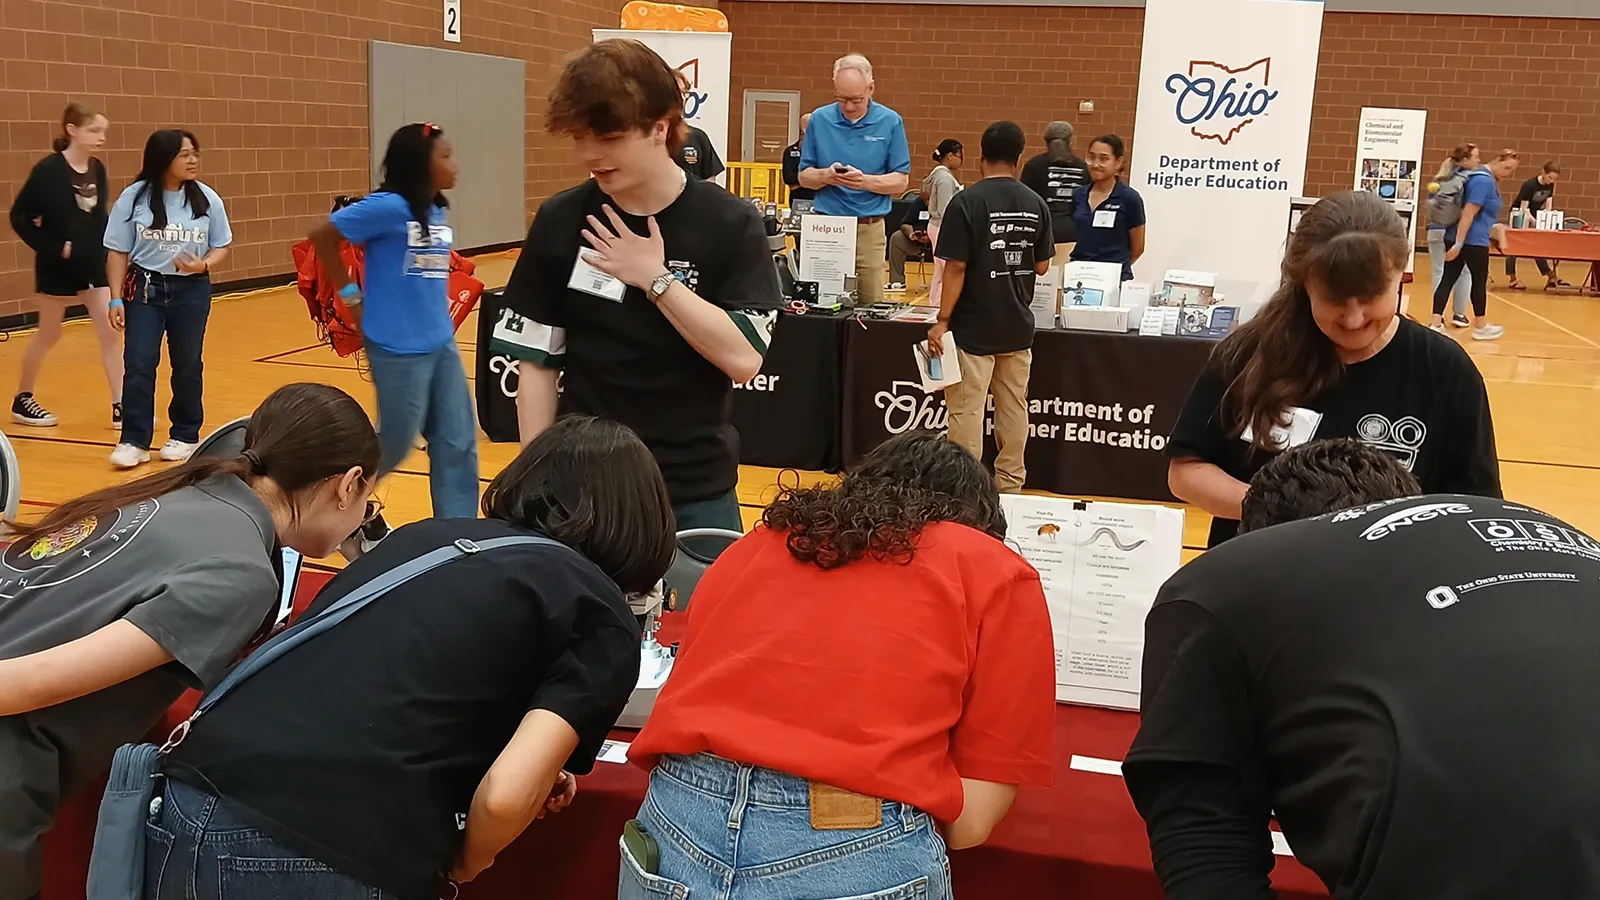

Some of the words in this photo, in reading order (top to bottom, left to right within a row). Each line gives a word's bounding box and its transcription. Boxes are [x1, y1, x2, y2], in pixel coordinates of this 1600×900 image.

[448, 7, 457, 35] 2
[1165, 73, 1279, 125] Ohio
[1159, 155, 1259, 172] Department
[1263, 158, 1282, 173] of
[1147, 172, 1201, 189] Higher
[1205, 174, 1288, 191] Education
[136, 223, 206, 243] Peanuts
[812, 225, 832, 234] Help
[874, 391, 949, 434] Ohi
[1128, 404, 1155, 424] of
[1065, 423, 1170, 451] Educatio
[1456, 581, 1475, 591] THE
[1475, 576, 1497, 586] OHIO
[1500, 573, 1525, 581] STATE
[1525, 571, 1576, 579] UNIVERSITY
